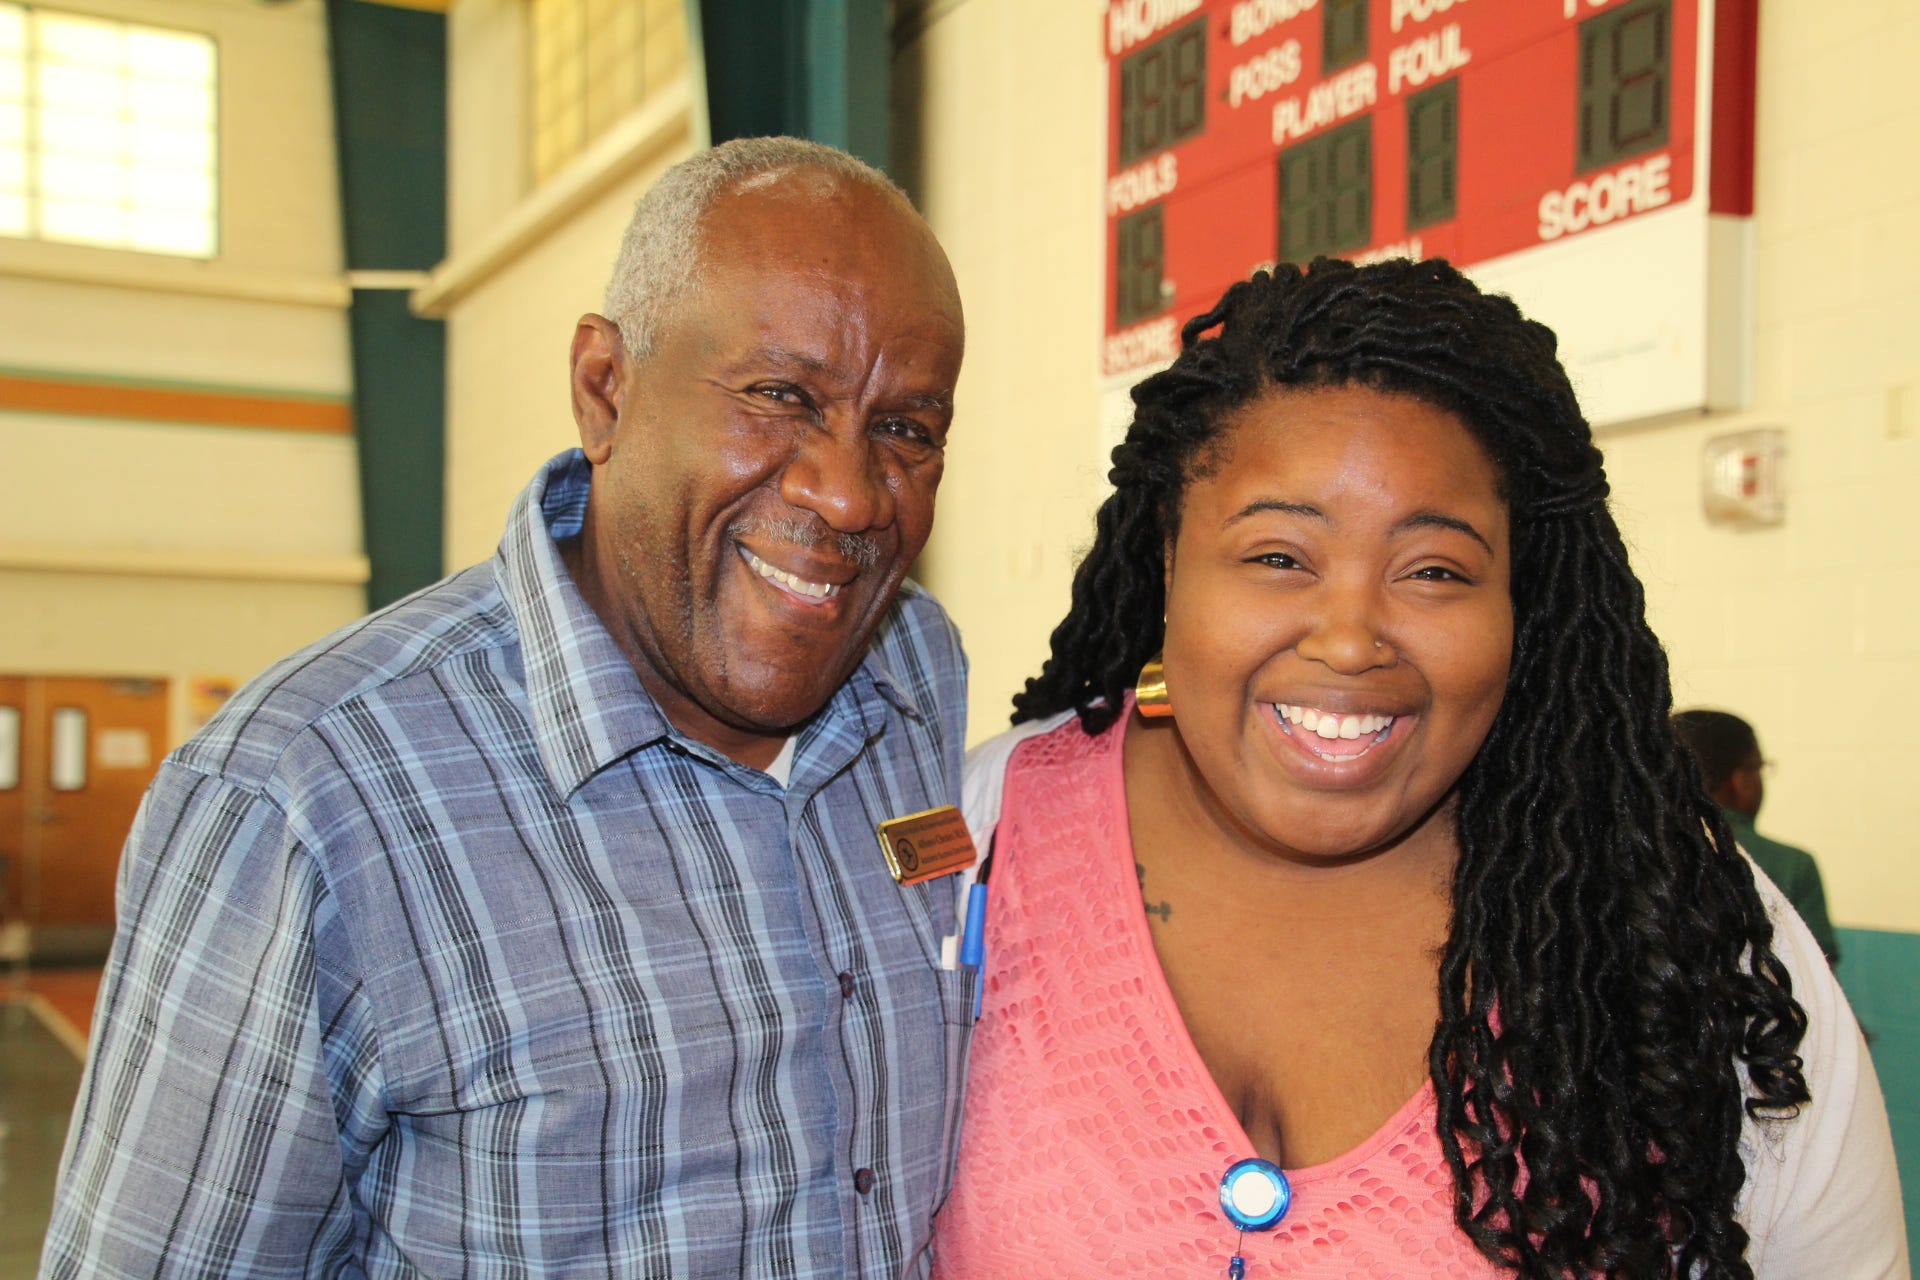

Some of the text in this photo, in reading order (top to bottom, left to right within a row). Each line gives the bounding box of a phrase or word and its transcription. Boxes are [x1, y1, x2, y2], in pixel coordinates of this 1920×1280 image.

[1230, 39, 1301, 108] POSS
[1272, 22, 1471, 145] PLAYER FOUL
[1107, 152, 1178, 216] FOULS
[1538, 154, 1672, 240] SCORE
